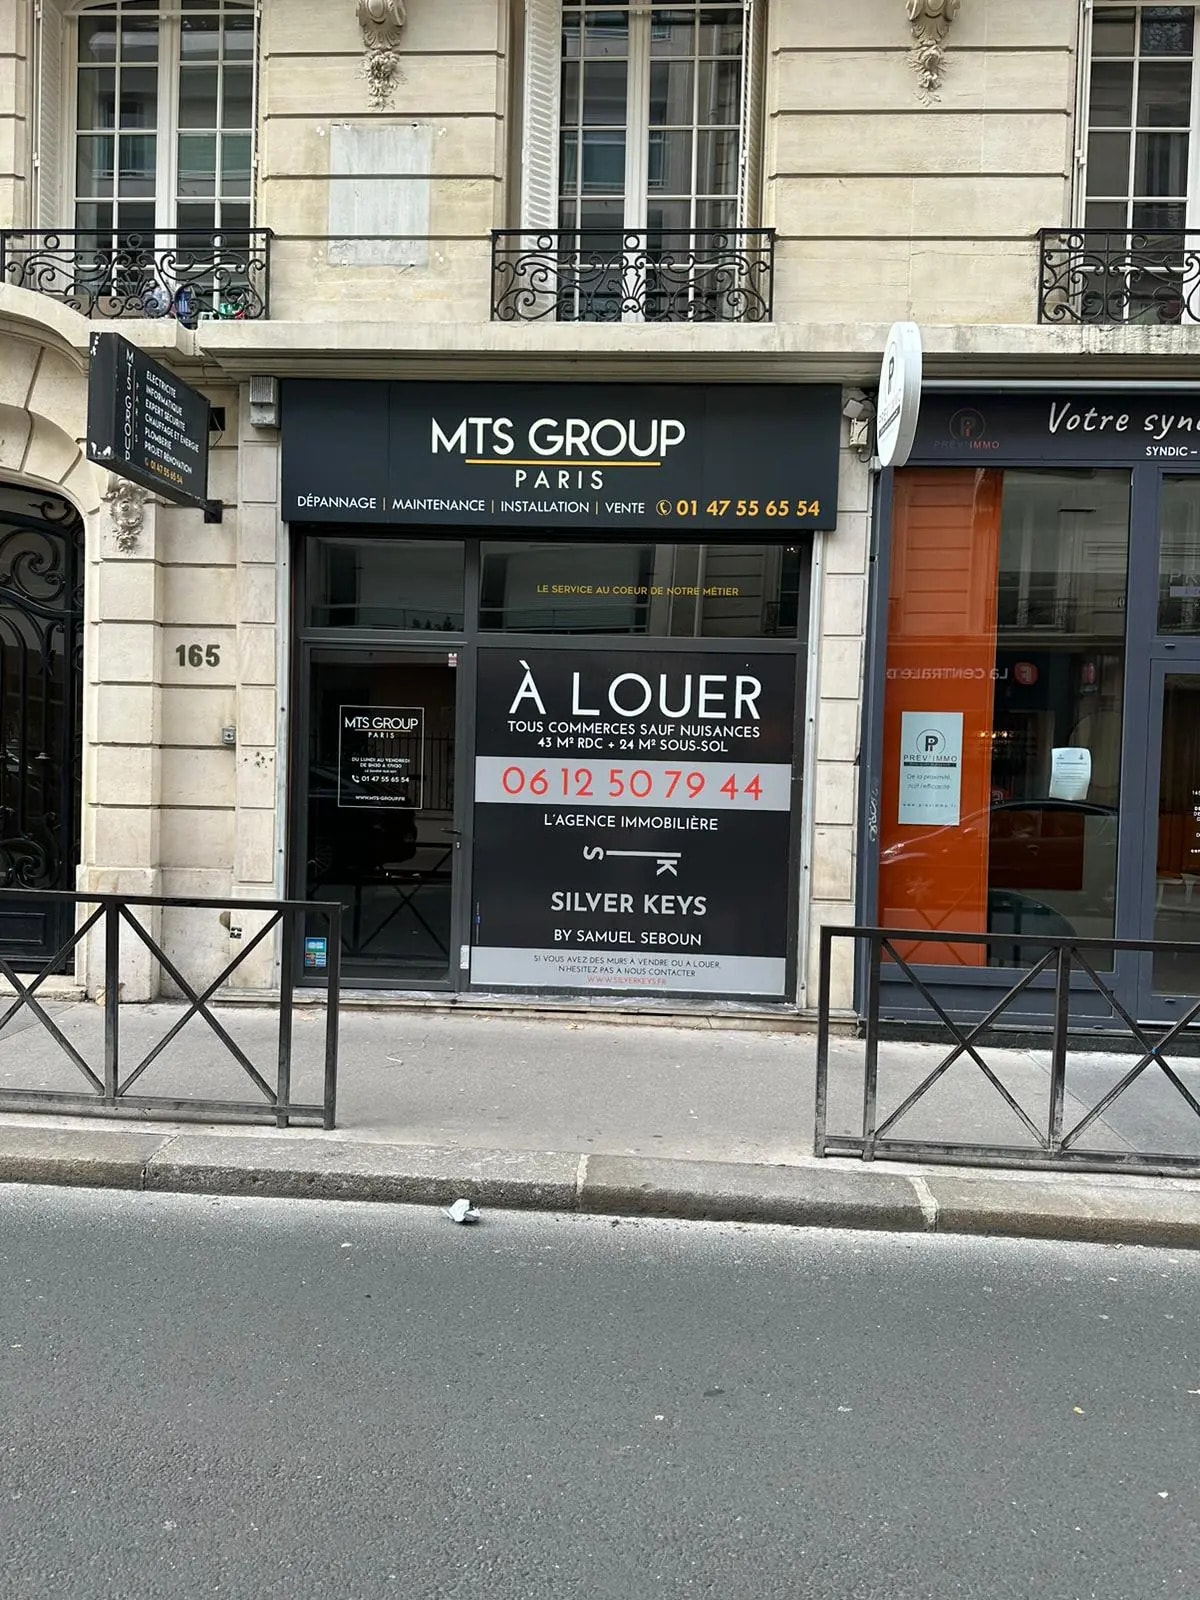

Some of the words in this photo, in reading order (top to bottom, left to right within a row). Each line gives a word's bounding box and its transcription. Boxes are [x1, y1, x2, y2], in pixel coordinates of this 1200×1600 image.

[145, 398, 163, 418] EXPERT
[1048, 402, 1130, 434] Votre
[144, 412, 173, 438] CHAUFFAGE
[144, 426, 172, 450] PLOMBERIE
[431, 417, 514, 456] MTS
[529, 418, 686, 457] GROUP
[144, 440, 163, 459] PROJET
[1146, 446, 1188, 456] SYNDIC
[514, 470, 604, 490] PARIS
[297, 493, 377, 510] DÉPANNAGE
[392, 498, 486, 513] MAINTENANCE
[501, 500, 590, 514] INSTALLATION
[605, 501, 645, 515] VENTE
[675, 500, 698, 516] 01
[705, 500, 731, 517] 47
[736, 501, 760, 517] 55
[765, 501, 790, 518] 65
[796, 501, 820, 518] 54
[537, 585, 549, 594] LE
[552, 585, 592, 594] SERVICE
[596, 586, 610, 594] AU
[612, 586, 648, 595] COEUR
[650, 586, 664, 596] DE
[667, 587, 700, 596] NOTRE
[703, 586, 738, 596] MÉTIER
[176, 644, 220, 668] 165
[509, 660, 546, 715] À
[572, 672, 762, 720] LOUER
[344, 716, 370, 729] MTS
[372, 717, 418, 730] GROUP
[508, 720, 544, 733] TOUS
[548, 722, 636, 735] COMMERCES
[640, 723, 675, 736] SAUF
[680, 724, 760, 738] NUISANCES
[536, 737, 552, 748] 43
[578, 738, 603, 750] RDC
[619, 738, 636, 750] 24
[660, 740, 728, 752] SOUS-SOL
[502, 766, 548, 795] 06
[561, 767, 594, 796] 12
[608, 768, 652, 798] 50
[664, 770, 706, 799] 79
[720, 772, 764, 801] 44
[544, 814, 616, 828] L'AGENCE
[620, 814, 718, 831] IMMOBILIÈRE
[550, 892, 634, 913] SILVER
[644, 894, 708, 916] KEYS
[554, 929, 572, 942] BY
[576, 930, 636, 944] SAMUEL
[640, 932, 702, 946] SEBOUN
[543, 955, 564, 963] VOUS
[638, 958, 668, 966] VENDRE
[600, 966, 614, 974] PAS
[624, 967, 646, 976] NOUS
[648, 968, 696, 977] CONTACTER
